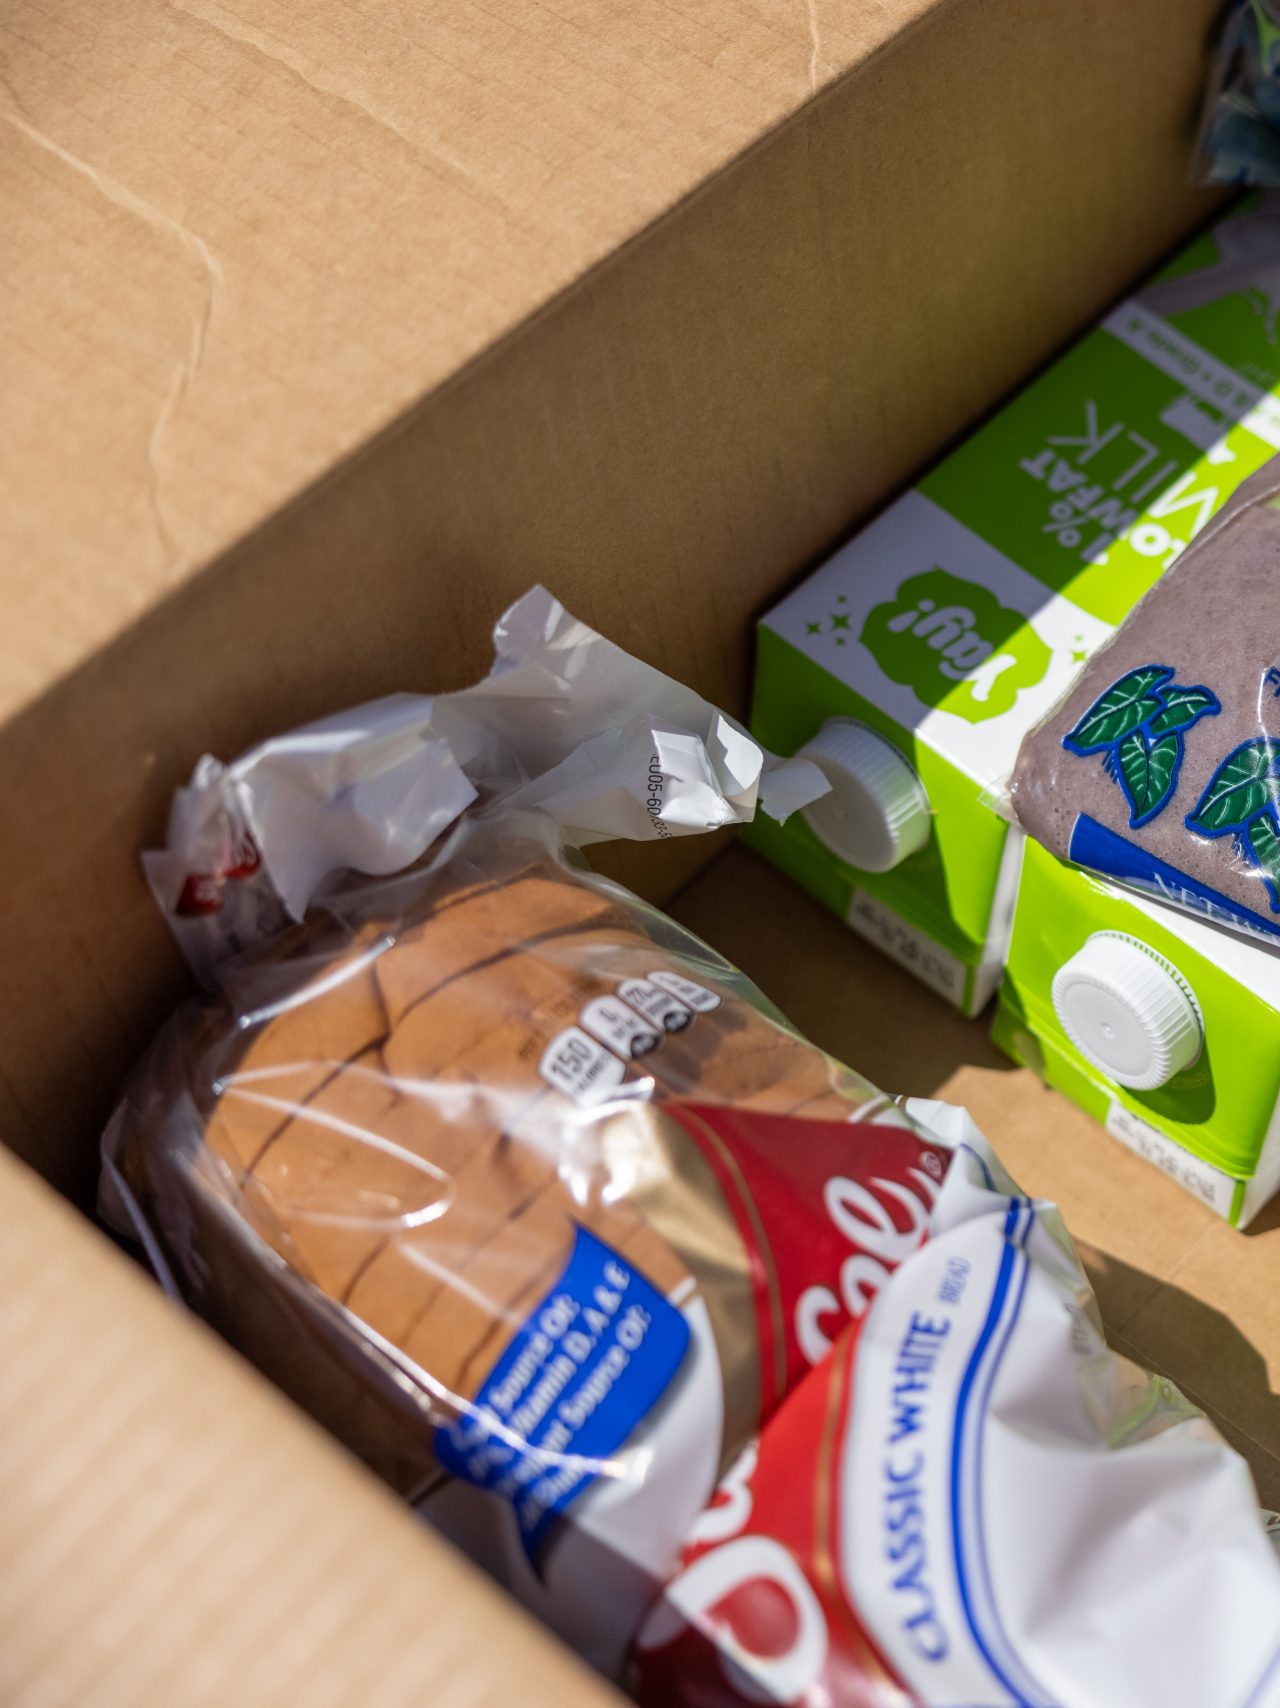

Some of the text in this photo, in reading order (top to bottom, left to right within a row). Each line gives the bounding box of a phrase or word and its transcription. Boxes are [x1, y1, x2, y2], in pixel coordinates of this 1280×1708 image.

[1043, 499, 1108, 566] 1%
[887, 597, 1018, 702] Yay!
[550, 1036, 594, 1079] 150
[887, 1309, 951, 1446] WHITE
[881, 1446, 950, 1662] CLASSIC
